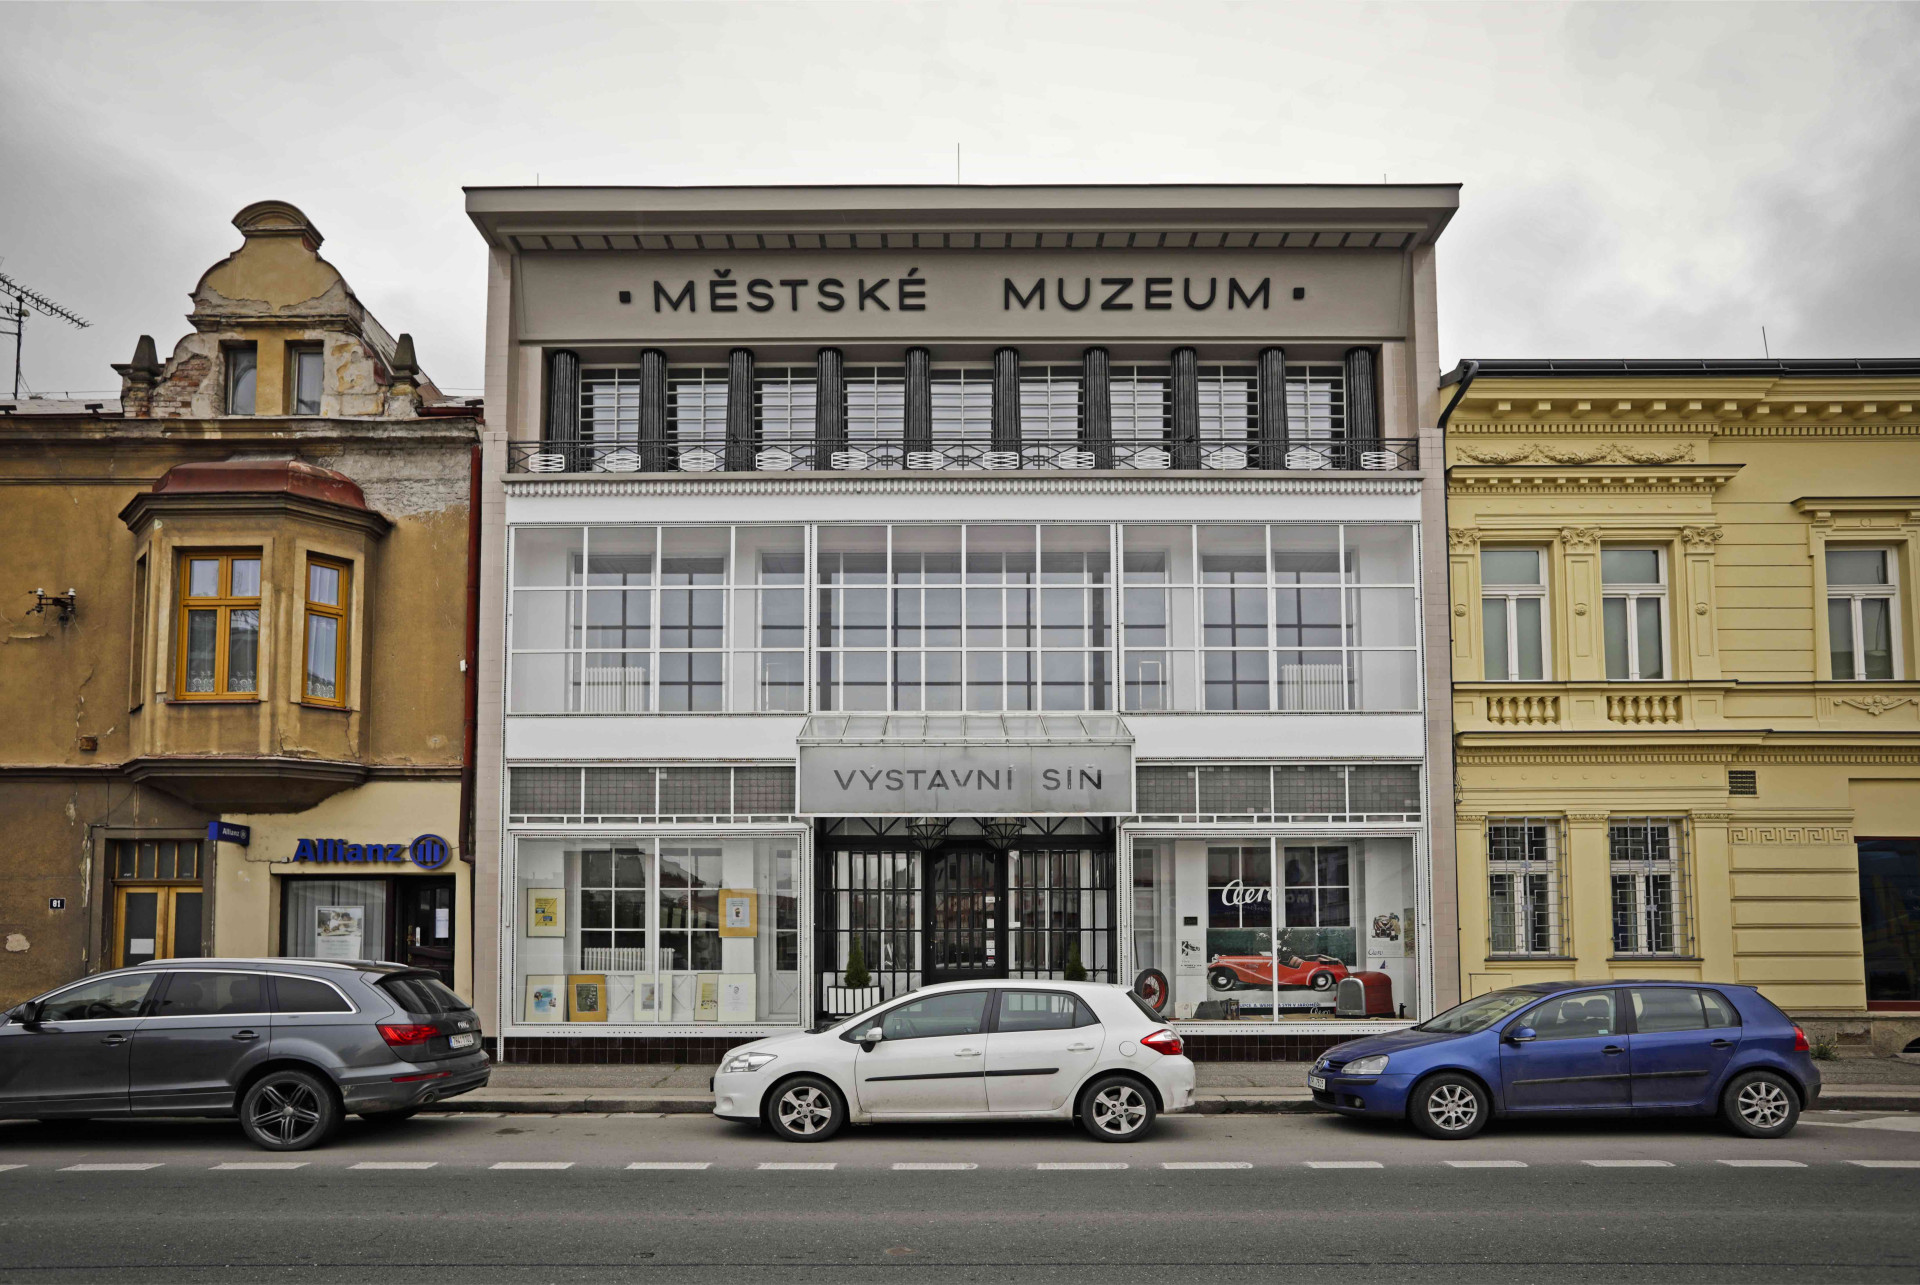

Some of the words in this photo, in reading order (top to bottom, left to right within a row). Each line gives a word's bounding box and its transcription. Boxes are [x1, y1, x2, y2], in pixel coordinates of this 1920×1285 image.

[653, 267, 926, 312] MĚSTSKÉ
[1004, 277, 1270, 311] MUZEUM
[833, 764, 1014, 791] VÝSTAVNÍ
[222, 827, 240, 837] Allianz
[292, 838, 403, 863] Allianz
[52, 899, 61, 908] 81
